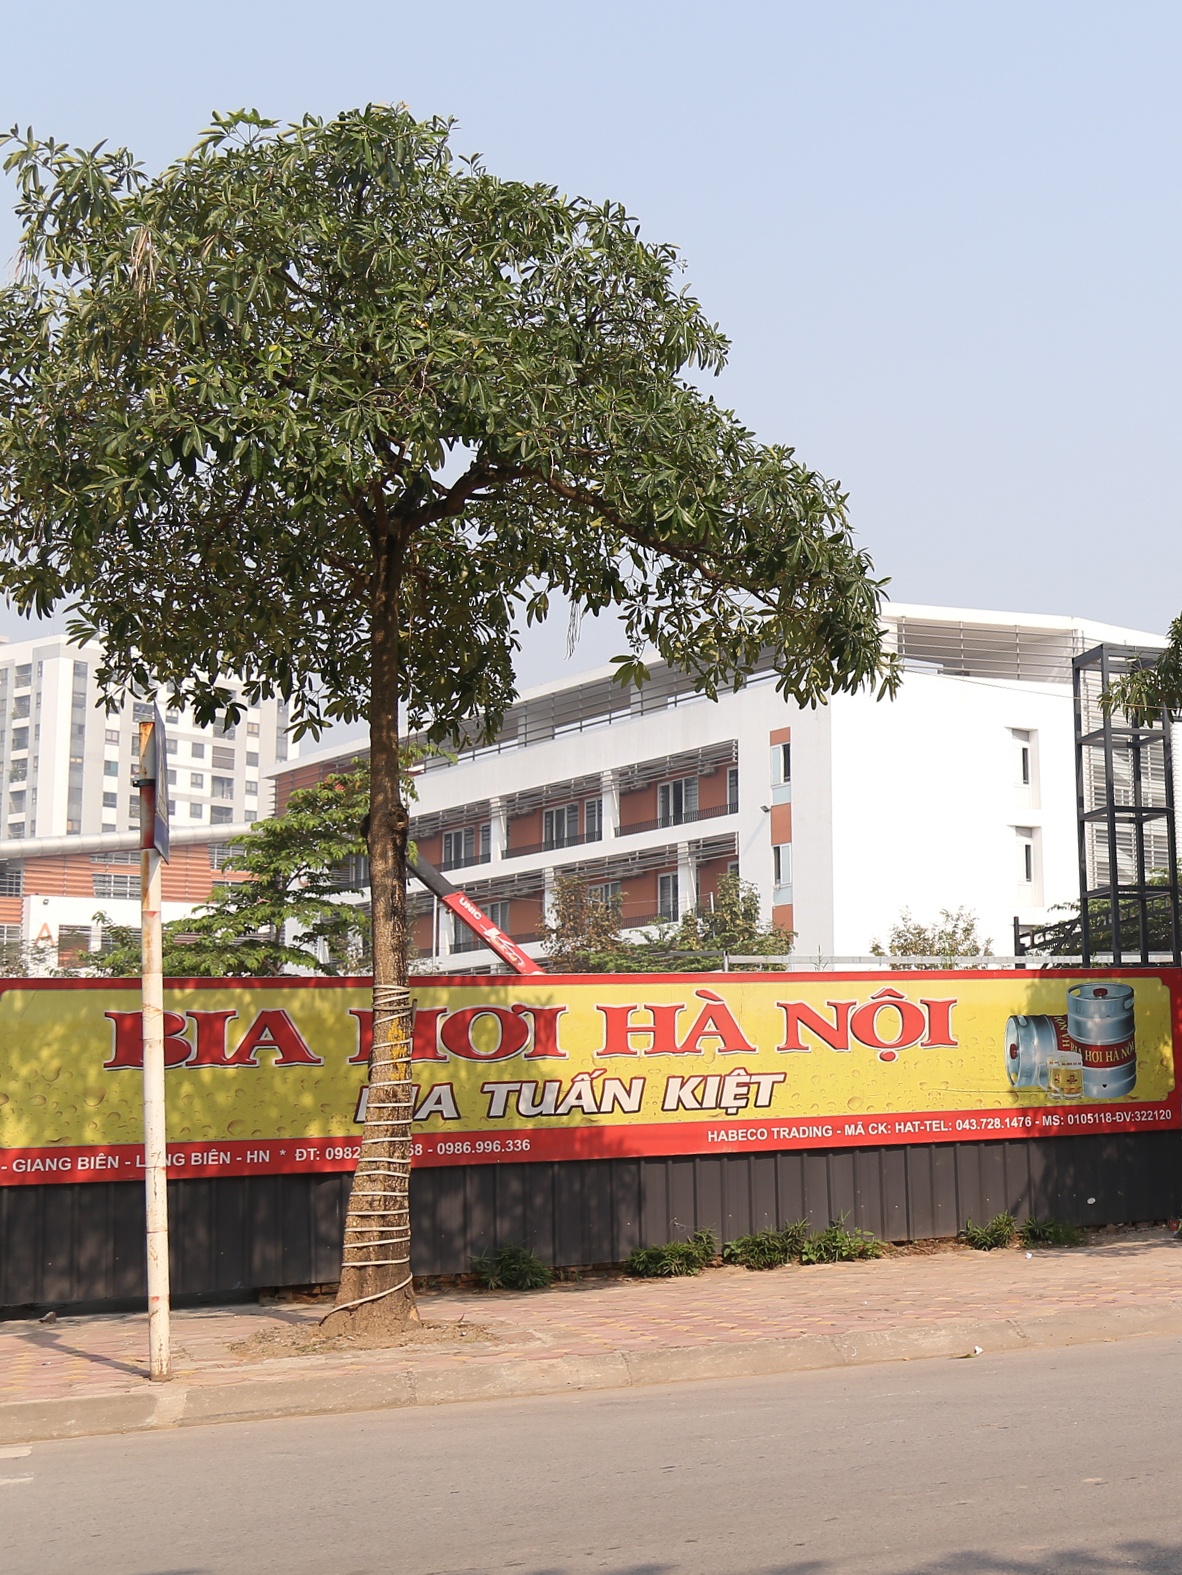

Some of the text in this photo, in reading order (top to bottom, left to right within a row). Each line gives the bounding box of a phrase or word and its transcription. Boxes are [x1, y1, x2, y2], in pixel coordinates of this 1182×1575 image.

[458, 897, 482, 920] UNIC
[103, 985, 958, 1070] BIA HƠI HÀ NỘI
[480, 1068, 646, 1118] TUẤN
[661, 1067, 787, 1115] KIỆT
[707, 1127, 768, 1143] HABECO
[772, 1124, 833, 1141] TRADING
[844, 1121, 865, 1136] MÃ
[868, 1122, 892, 1136] CK:
[895, 1120, 952, 1134] HAT-TEL:
[955, 1116, 1032, 1131] 043.728.1476
[1042, 1114, 1064, 1127] MS:
[1067, 1109, 1172, 1125] 0105118-ĐV:322120
[12, 1156, 72, 1173] GIANG
[77, 1152, 119, 1171] BIÊN
[190, 1148, 231, 1166] BIÊN
[246, 1149, 270, 1164] HN
[295, 1148, 321, 1162] ĐT:
[437, 1138, 531, 1155] 0986.996.336
